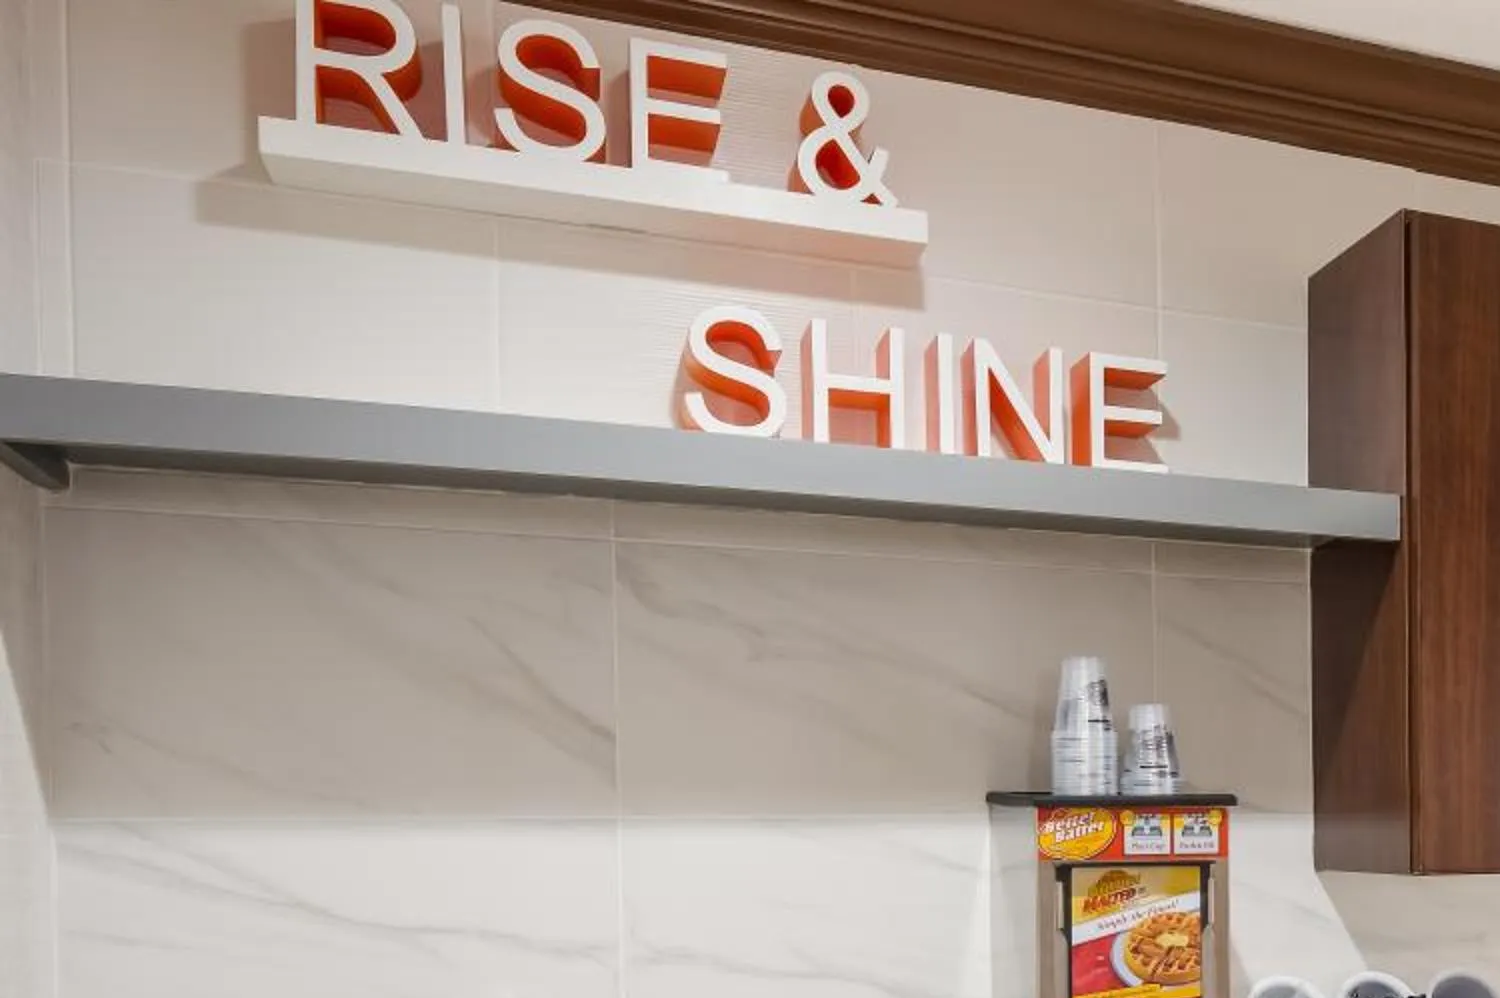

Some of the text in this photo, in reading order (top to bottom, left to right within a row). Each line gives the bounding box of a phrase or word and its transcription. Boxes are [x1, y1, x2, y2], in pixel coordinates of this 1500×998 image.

[296, 0, 898, 208] RISE &
[682, 305, 1170, 474] SHINE
